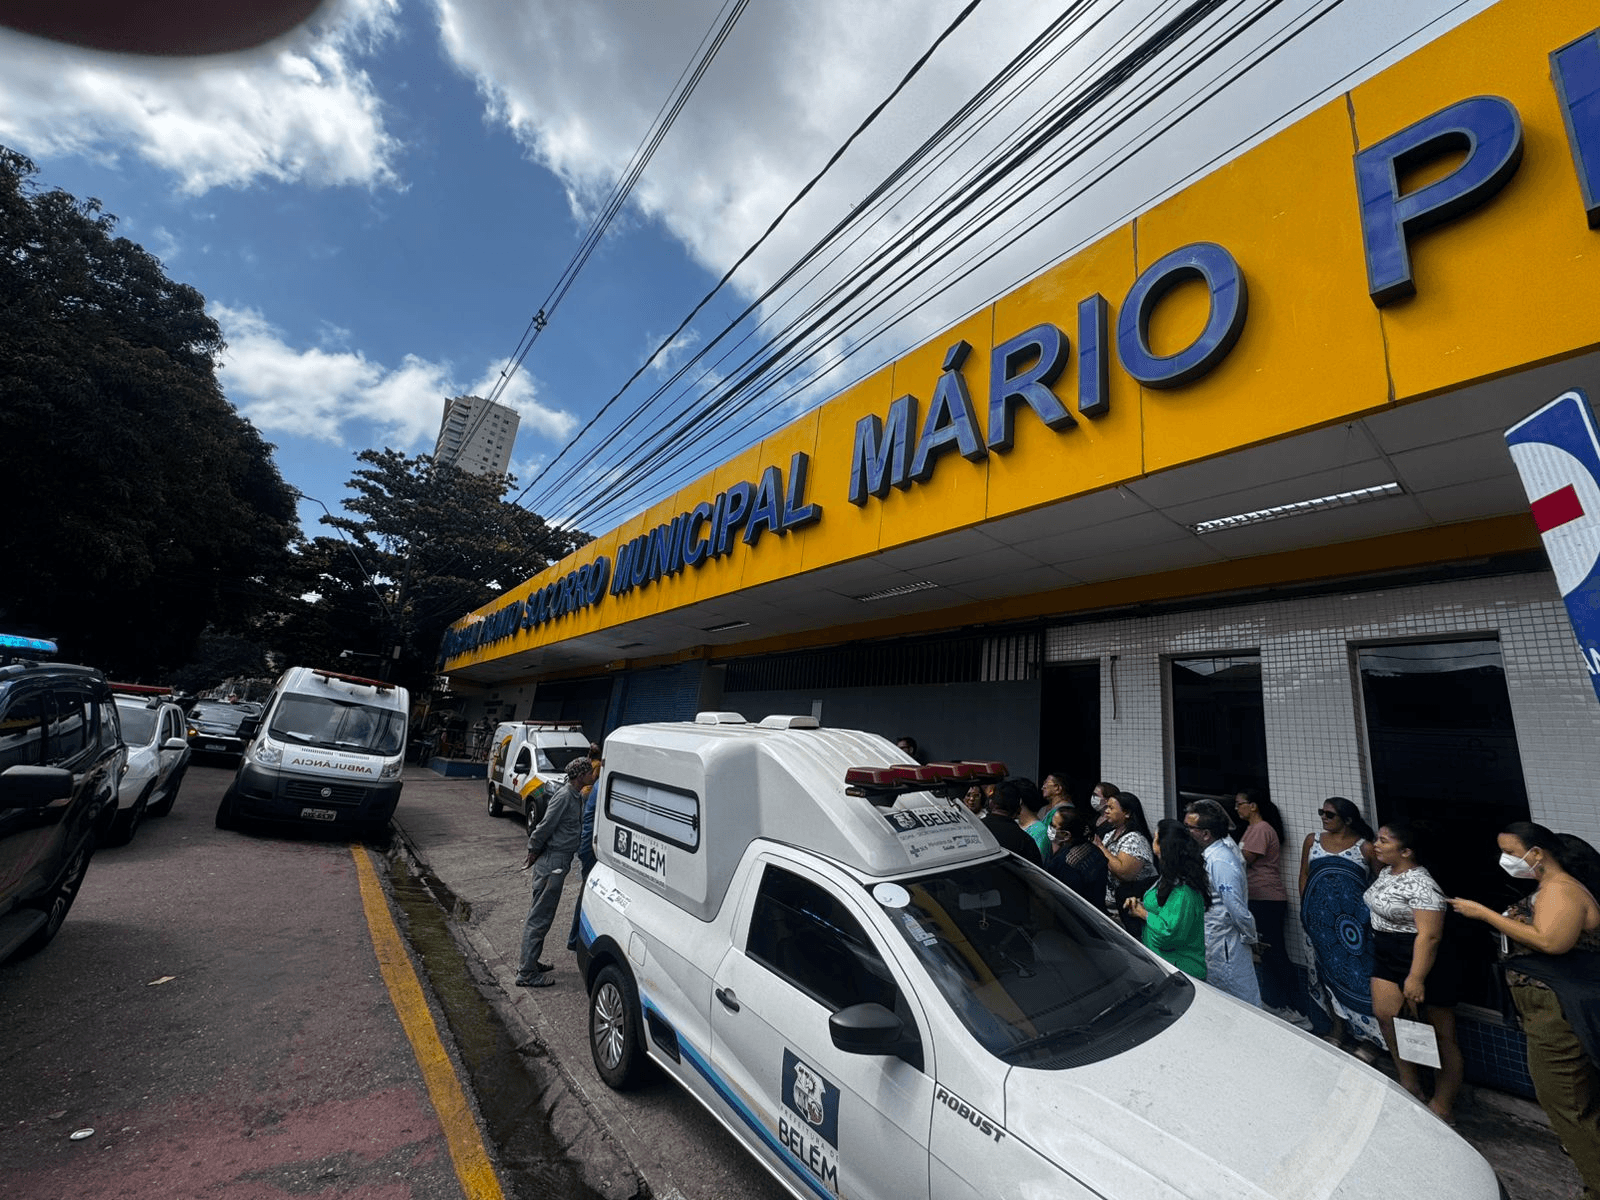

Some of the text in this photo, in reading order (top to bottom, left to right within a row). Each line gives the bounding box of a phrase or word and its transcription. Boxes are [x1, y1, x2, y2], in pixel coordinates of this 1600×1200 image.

[521, 556, 611, 629] SOCORRO
[610, 451, 823, 596] MUNICIPAL
[848, 241, 1249, 508] MÁRIO
[918, 809, 969, 827] BELÉM
[631, 840, 666, 877] BELÉM
[781, 1104, 839, 1163] PREFEITURA DE
[936, 1088, 1006, 1143] ROBUST
[779, 1115, 839, 1194] BELÉM
